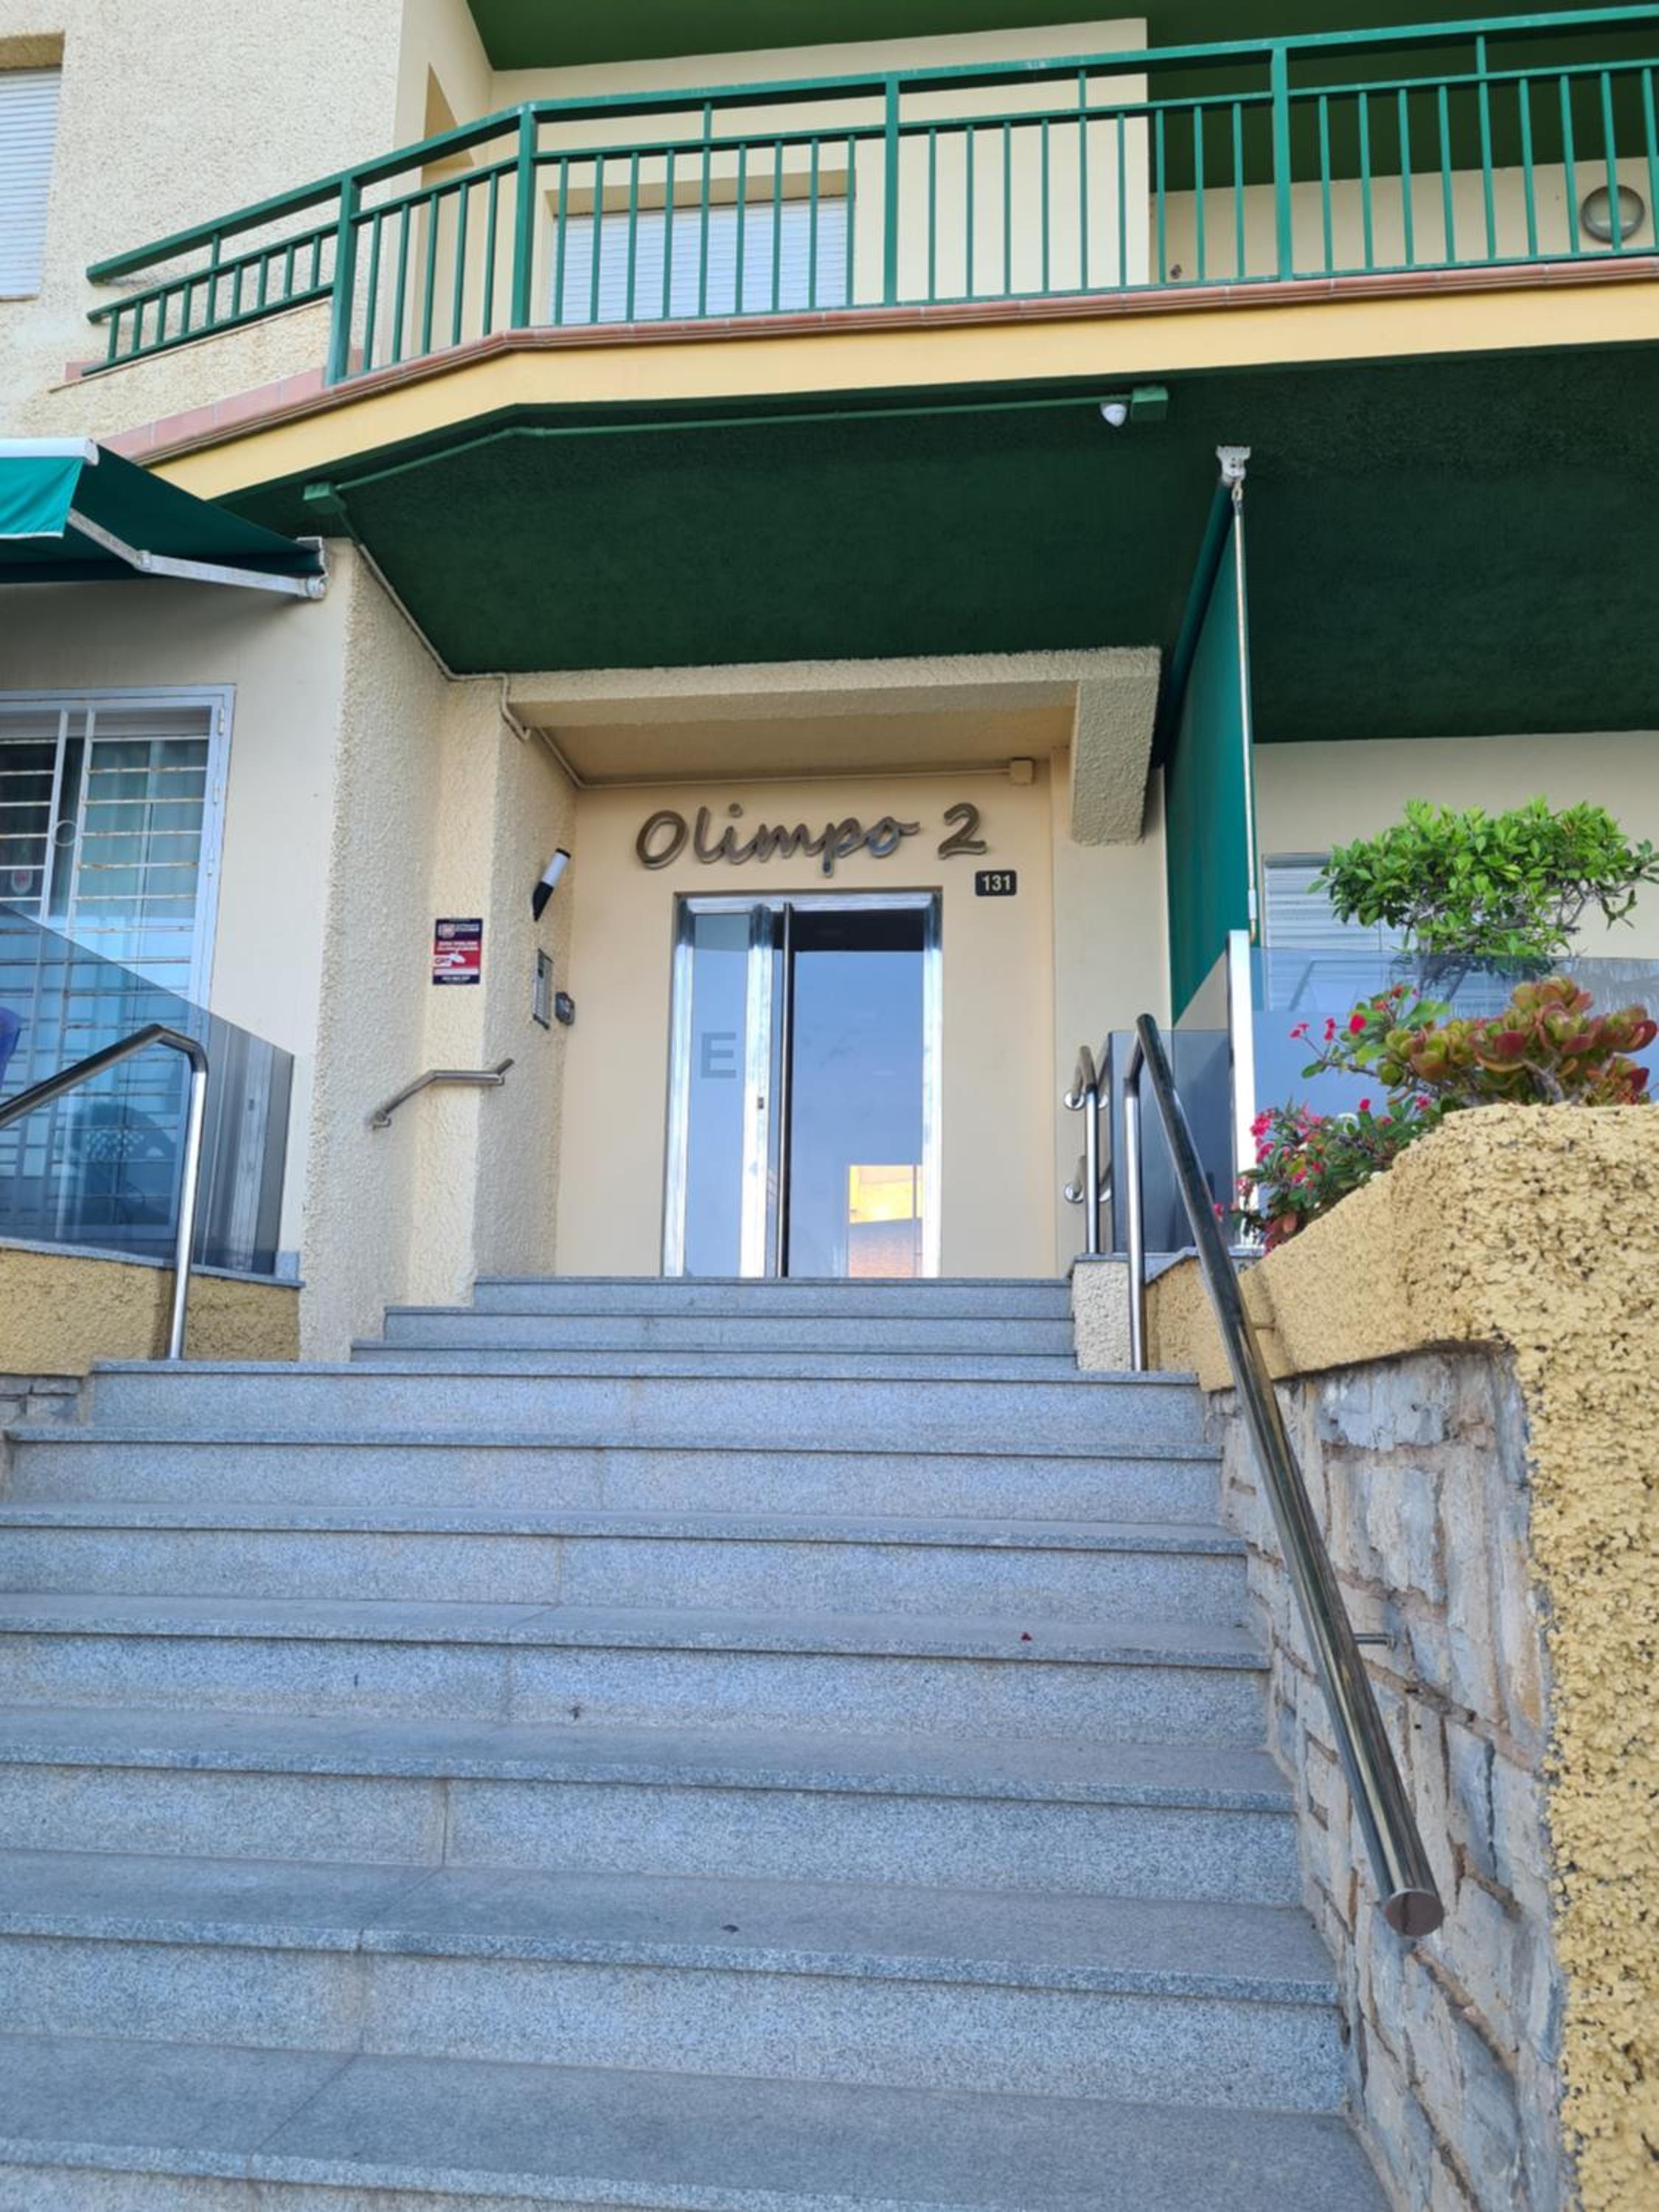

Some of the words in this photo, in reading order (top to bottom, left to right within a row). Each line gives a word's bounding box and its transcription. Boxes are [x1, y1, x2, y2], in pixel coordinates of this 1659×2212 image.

[636, 802, 920, 877] Olimpo
[937, 801, 988, 860] 2
[982, 874, 1012, 891] 131
[701, 1032, 737, 1078] E
